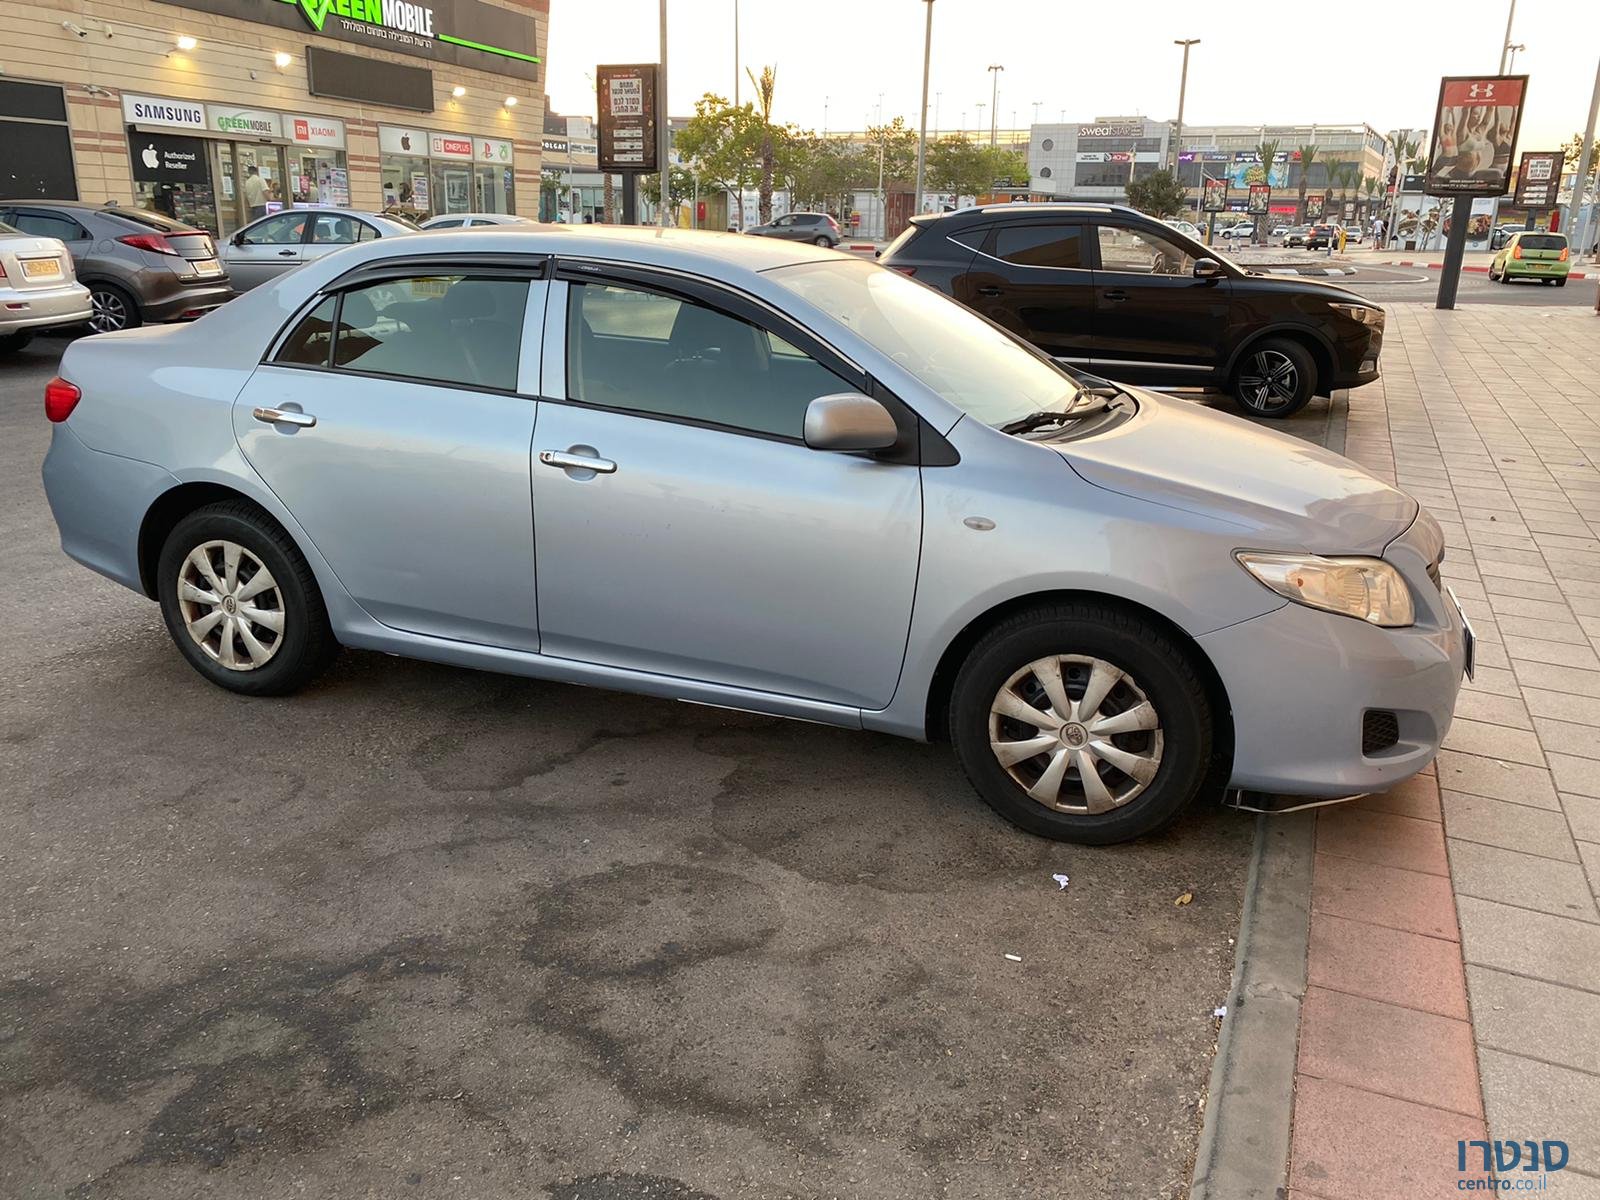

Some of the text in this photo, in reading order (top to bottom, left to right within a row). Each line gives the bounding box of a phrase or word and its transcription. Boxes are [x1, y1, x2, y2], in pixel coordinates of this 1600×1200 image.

[340, 19, 366, 34] הסלולר
[134, 103, 201, 123] SAMSUNG
[310, 127, 336, 137] XIAOMI
[164, 151, 196, 161] Authorized
[164, 161, 188, 169] Reseller
